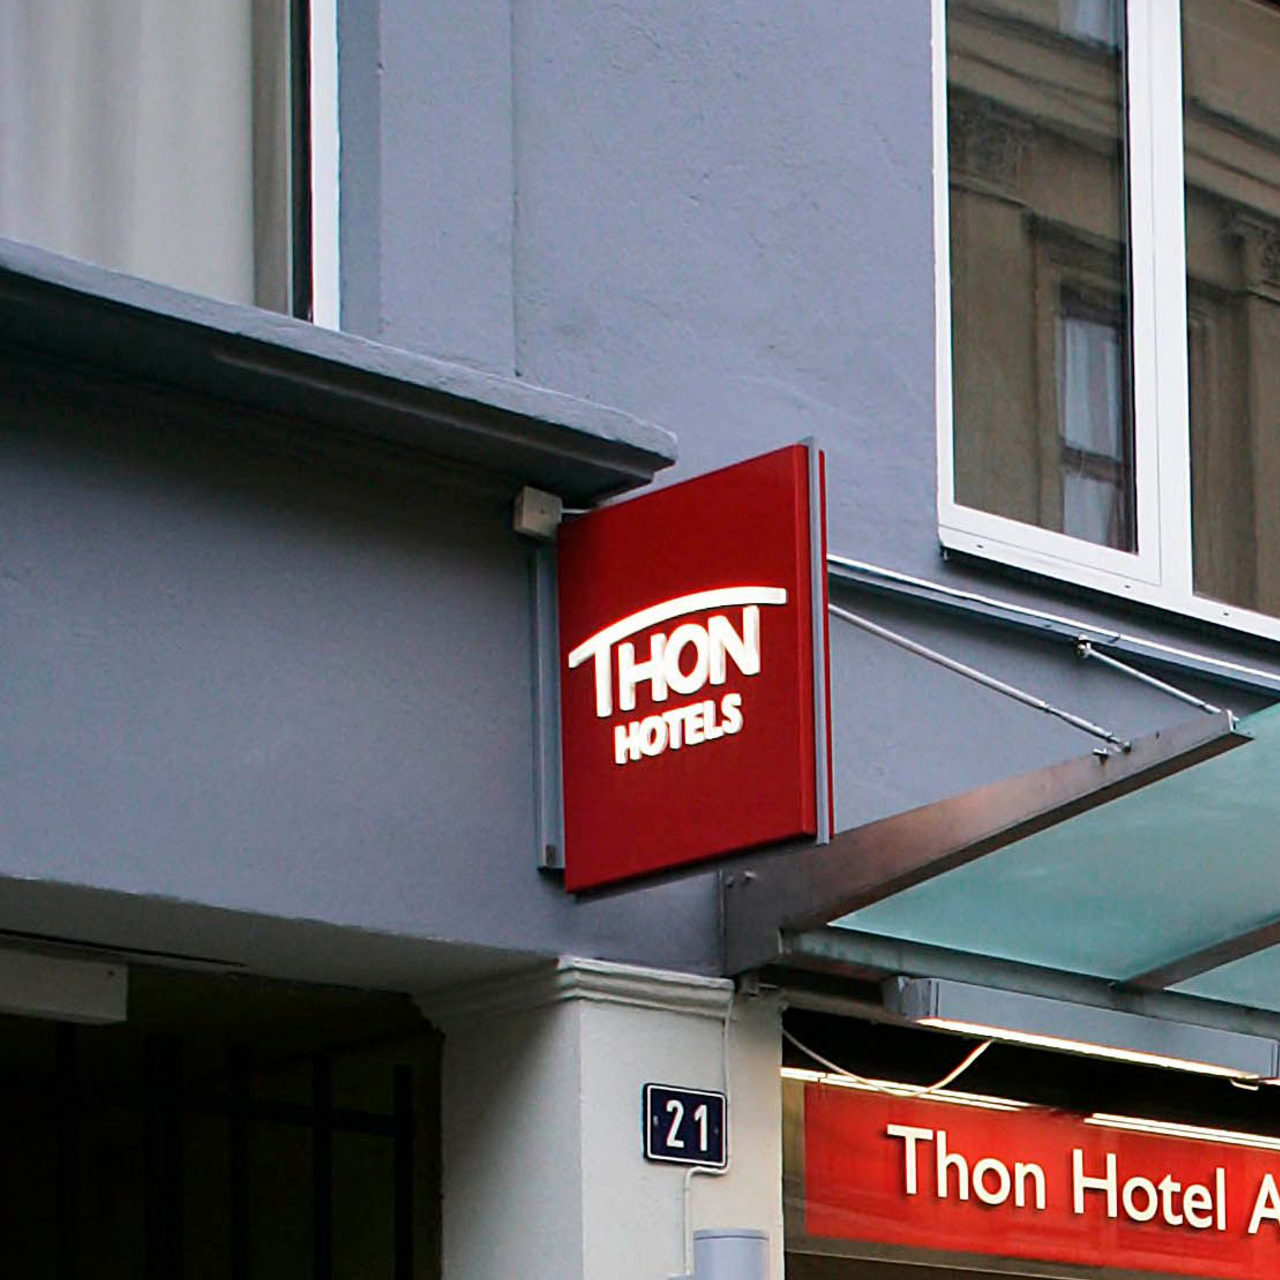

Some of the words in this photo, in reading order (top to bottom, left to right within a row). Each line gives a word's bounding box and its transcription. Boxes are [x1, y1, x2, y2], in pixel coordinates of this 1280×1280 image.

[568, 586, 787, 718] THON
[614, 693, 743, 765] HOTELS
[666, 1099, 708, 1152] 21
[887, 1123, 1046, 1211] Thon
[1072, 1147, 1226, 1232] Hotel
